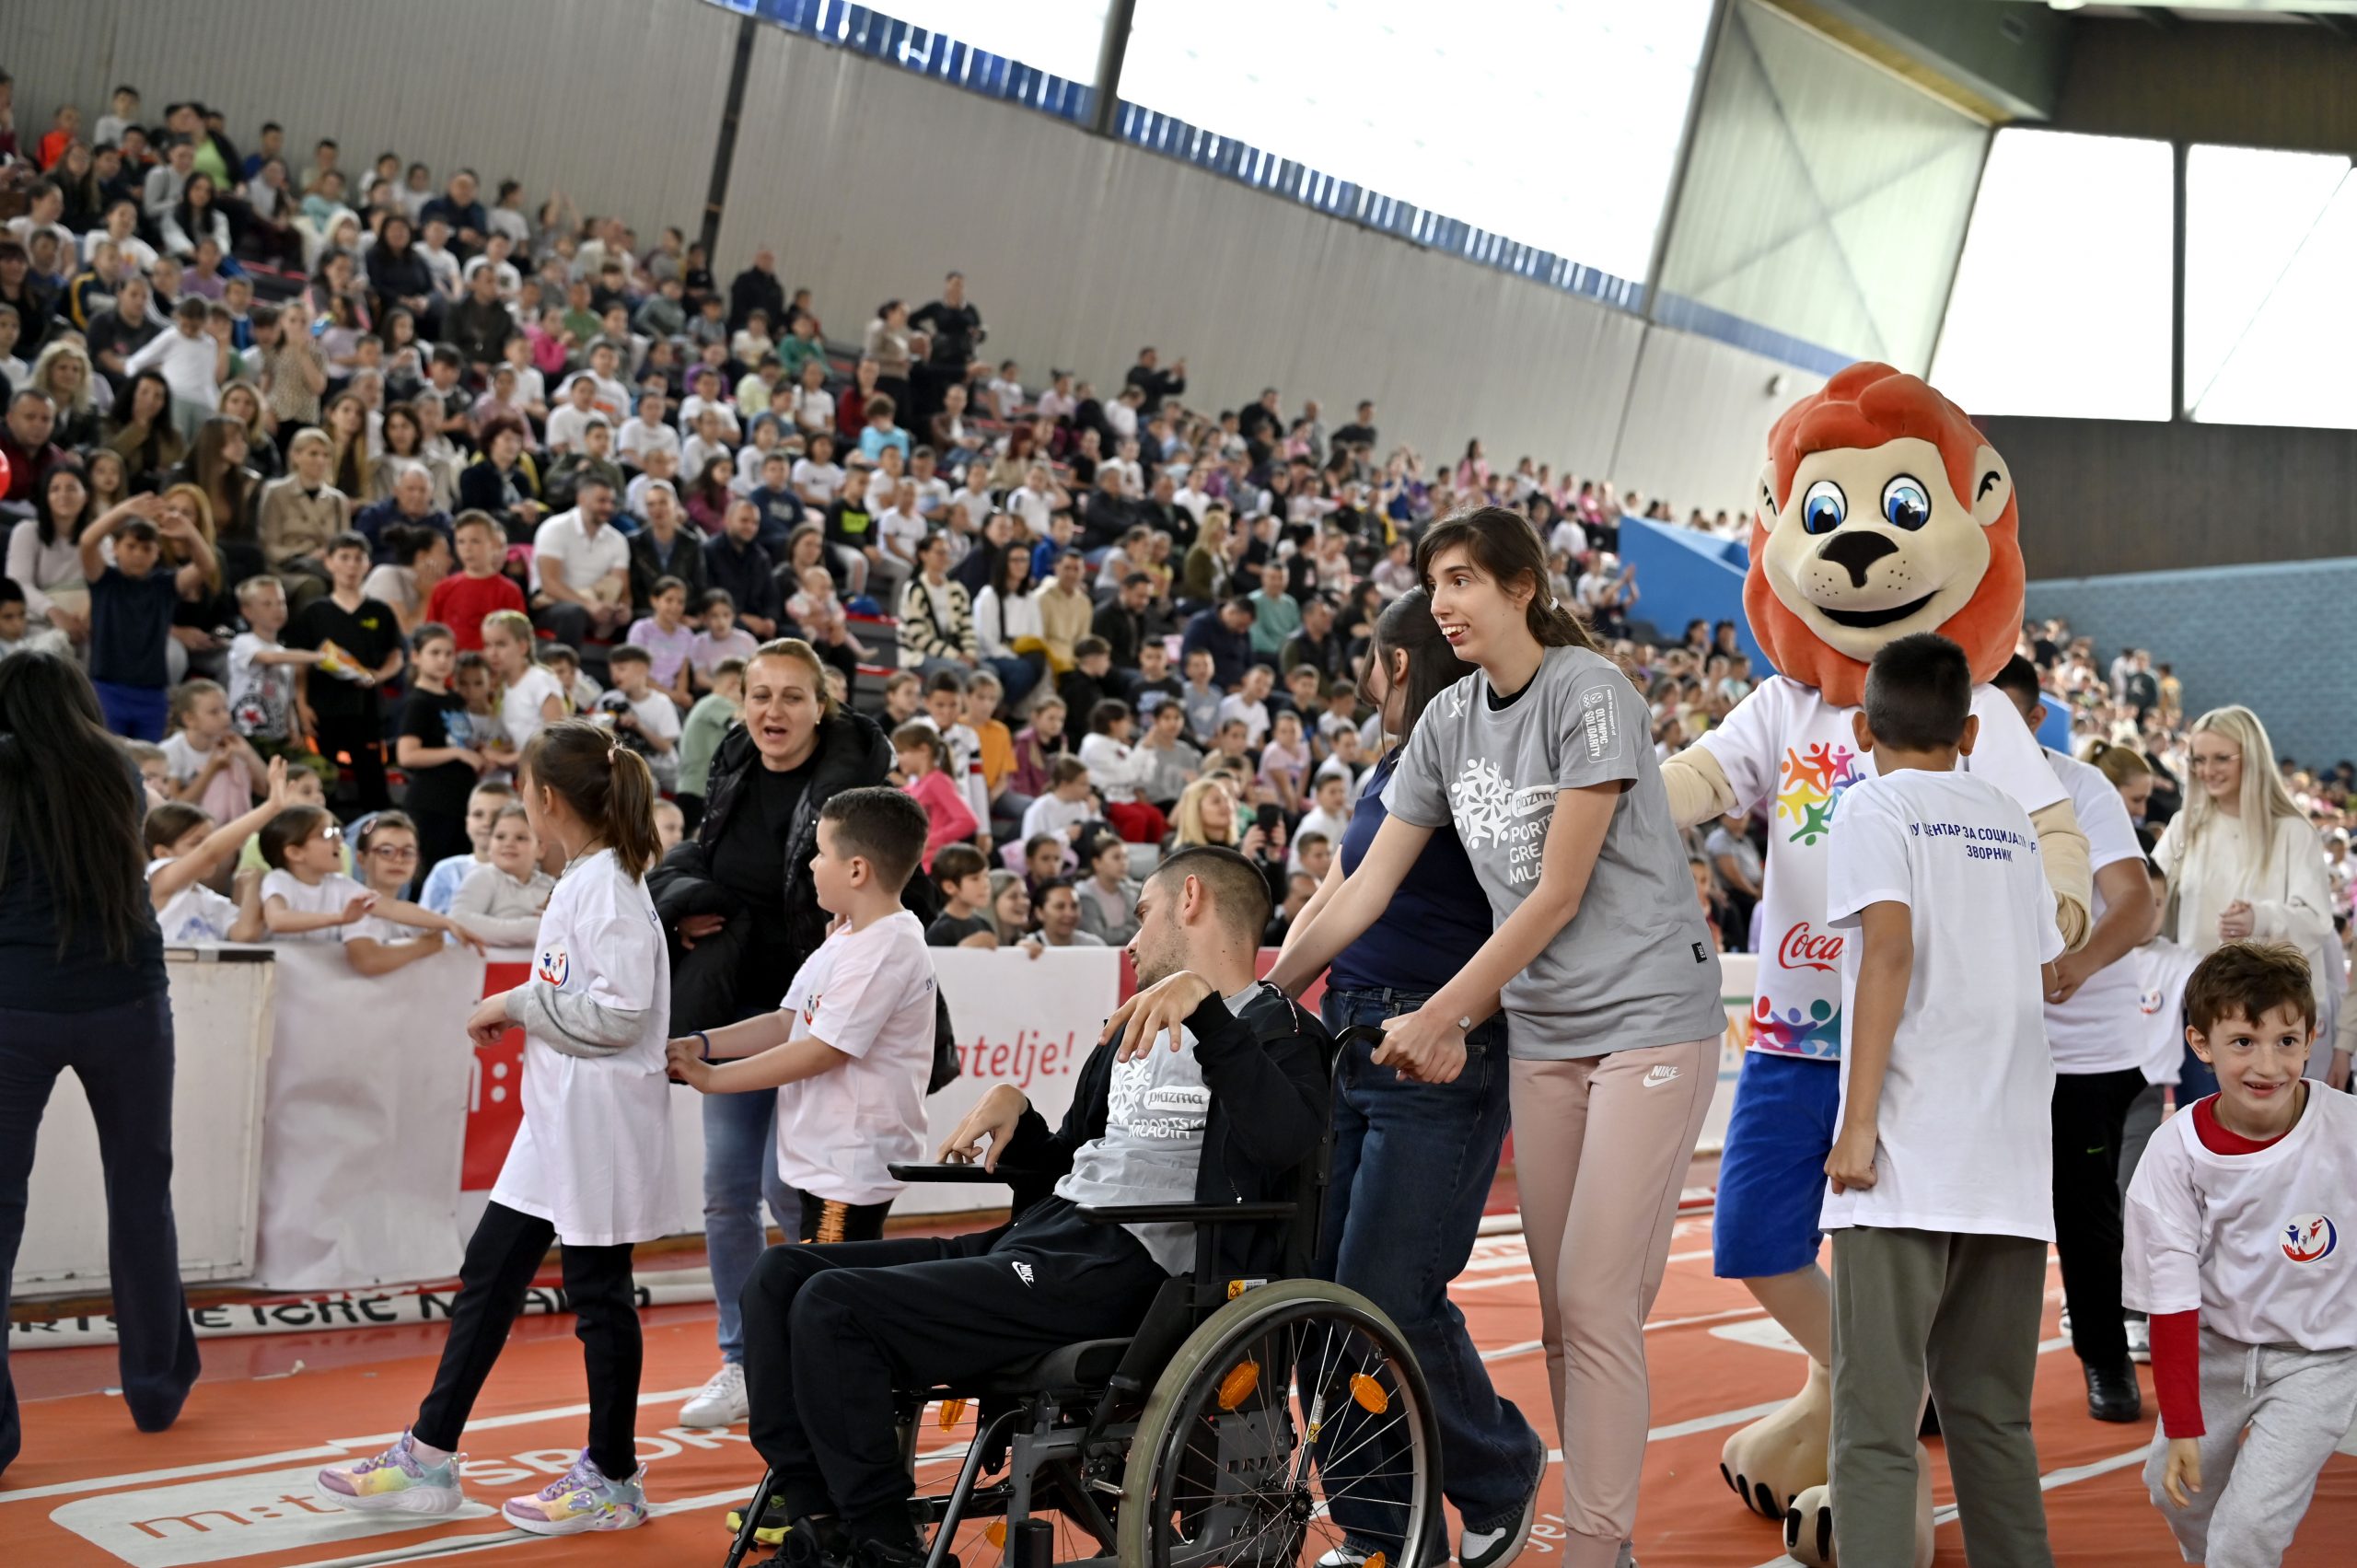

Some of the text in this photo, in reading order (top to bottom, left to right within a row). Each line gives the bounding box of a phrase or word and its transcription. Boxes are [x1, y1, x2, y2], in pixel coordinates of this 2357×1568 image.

[1585, 710, 1600, 757] SOLIDARITY
[1595, 708, 1608, 744] OLYMPIC
[1922, 822, 1961, 838] ЦЕНТАР
[1962, 826, 1977, 840] ЗА
[1966, 844, 2014, 863] ЗВОРНИК
[1778, 922, 1844, 973] Coca
[1651, 1065, 1678, 1077] NIKE
[1147, 1092, 1203, 1107] plazma
[1019, 1264, 1035, 1283] NIKE
